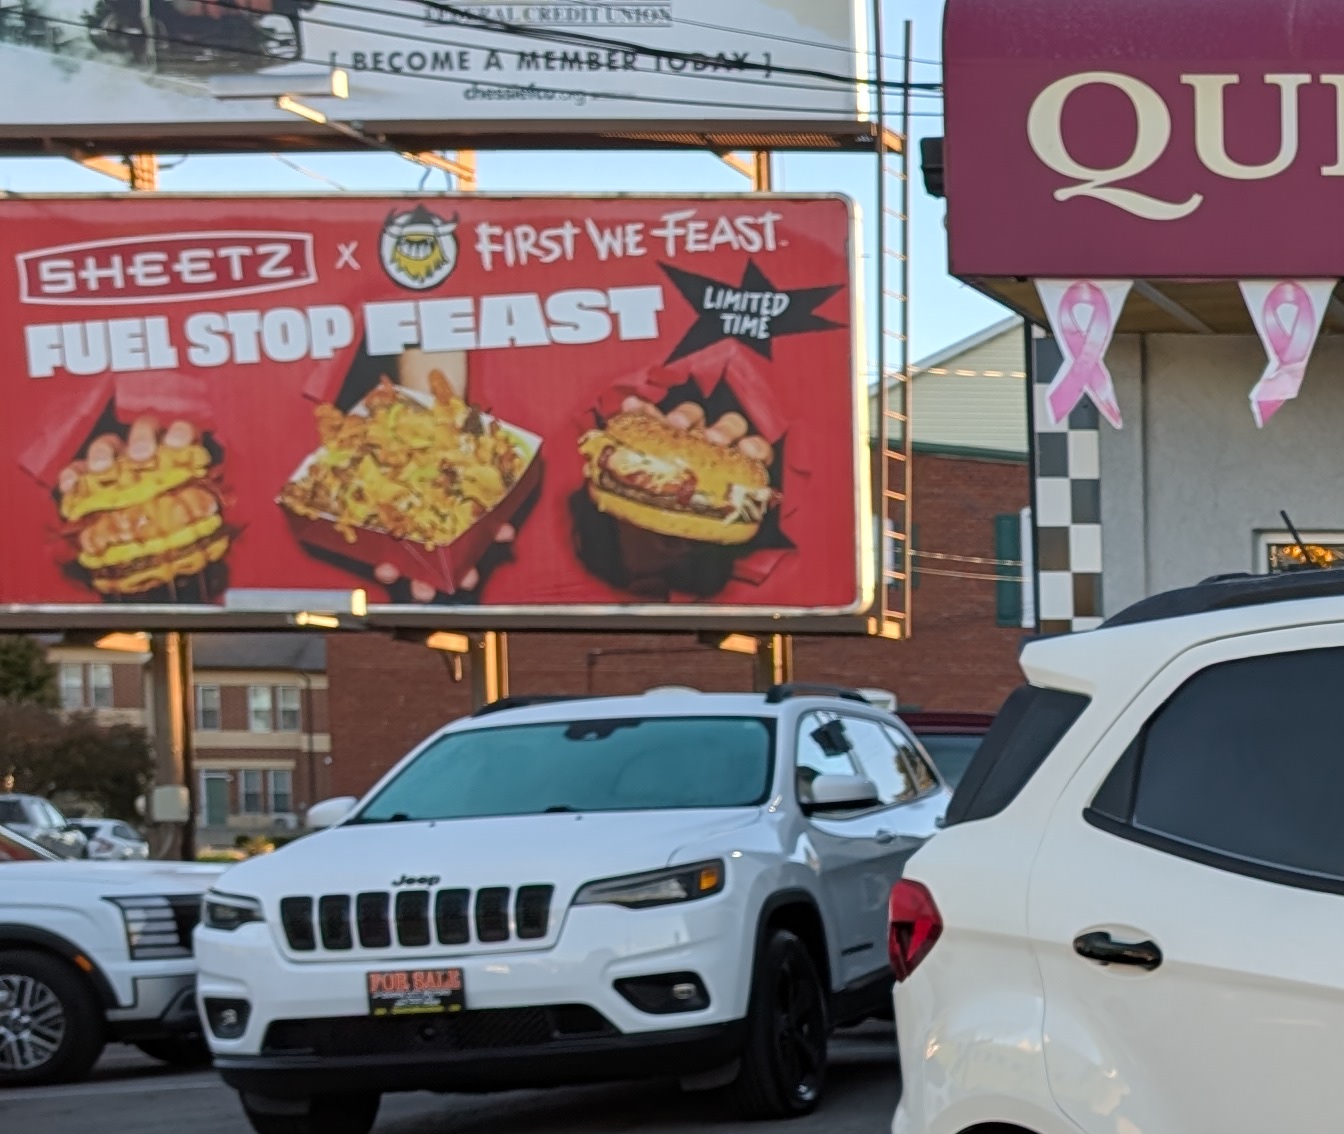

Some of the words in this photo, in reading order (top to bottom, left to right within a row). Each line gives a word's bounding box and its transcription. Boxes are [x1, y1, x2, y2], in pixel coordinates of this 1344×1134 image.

[352, 50, 470, 72] BECOME
[483, 49, 503, 71] A
[516, 50, 639, 72] MEMBER
[475, 219, 581, 271] FIRST
[584, 217, 648, 262] WE
[38, 243, 294, 294] SHEETZ
[703, 285, 790, 318] LIMITED
[24, 315, 179, 379] FUEL
[184, 304, 355, 367] STOP
[363, 284, 666, 356] FEAST
[720, 312, 771, 340] TIME
[391, 873, 441, 887] Jeep
[369, 972, 410, 994] FOR
[412, 967, 462, 991] SALE
